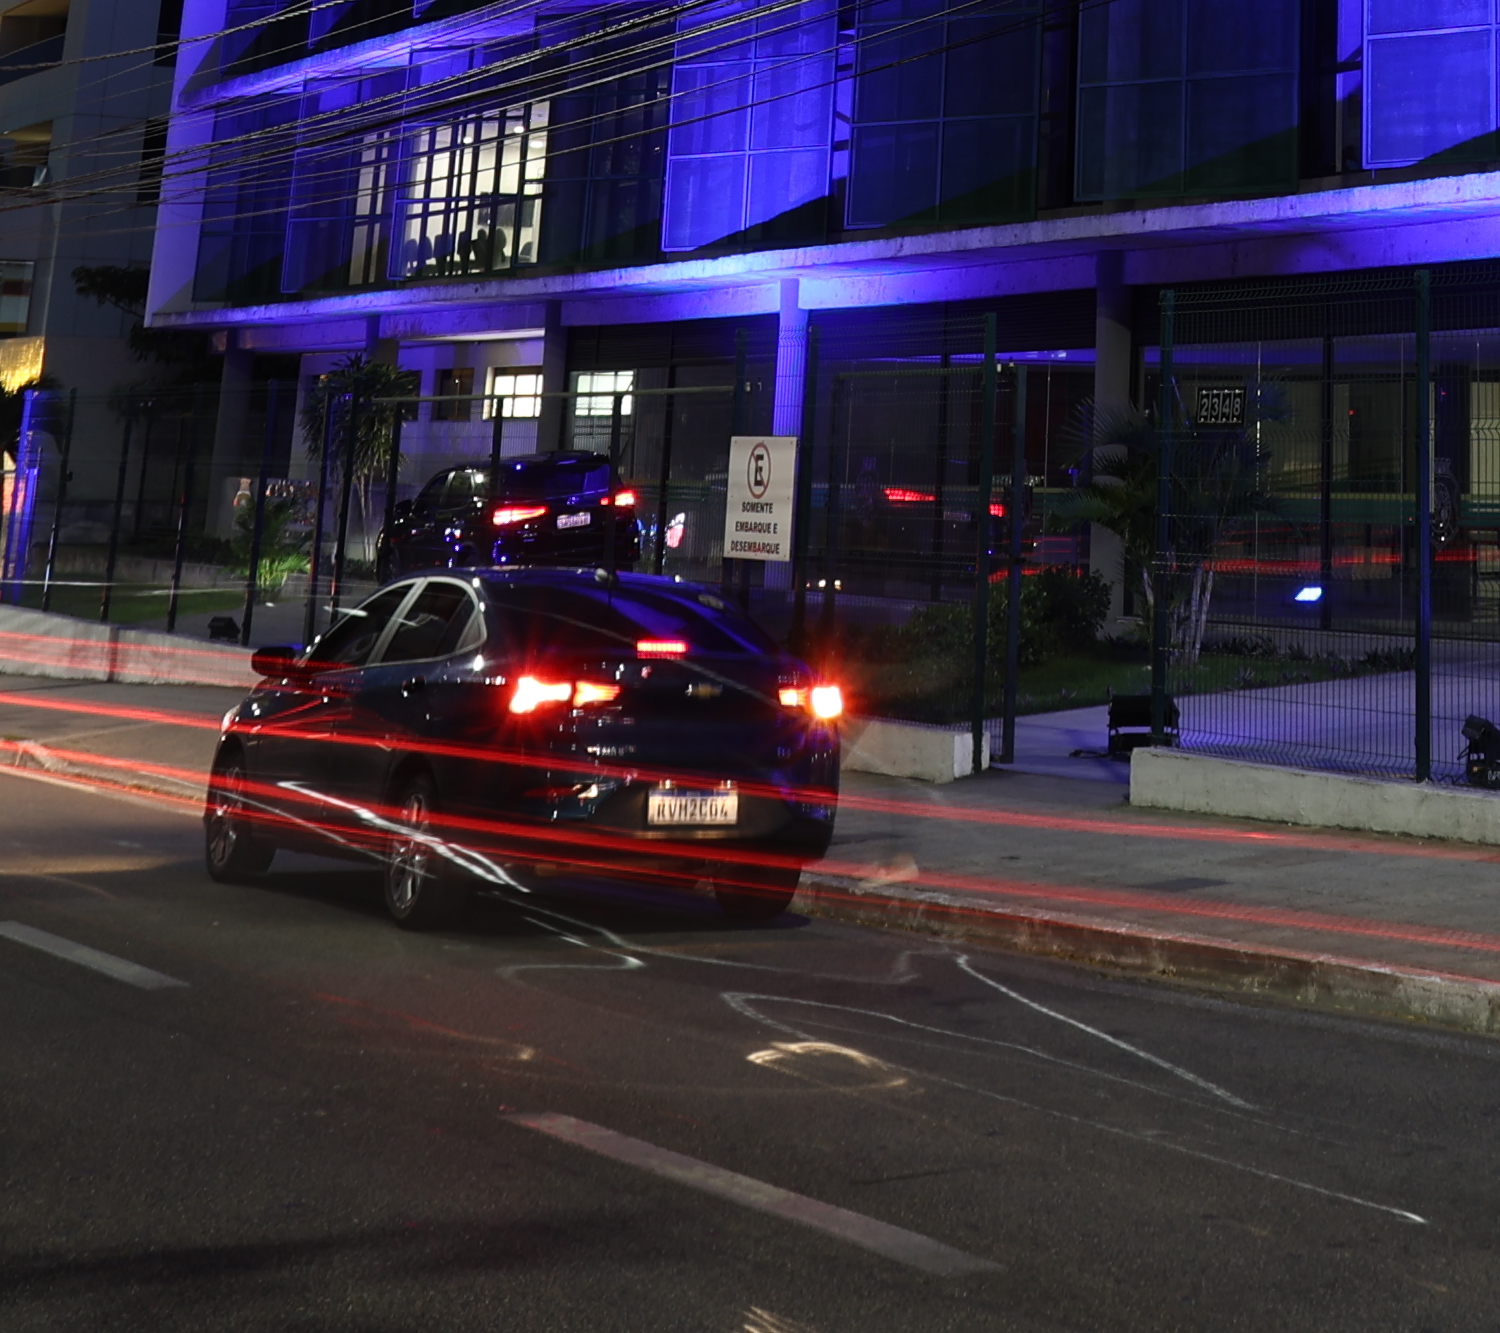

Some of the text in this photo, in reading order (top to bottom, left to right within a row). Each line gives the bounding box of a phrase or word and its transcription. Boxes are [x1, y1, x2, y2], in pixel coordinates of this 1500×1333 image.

[1201, 397, 1240, 416] 2348
[742, 501, 774, 514] SOMENTE
[735, 521, 778, 534] EMBARQUE E
[731, 540, 780, 554] DESEMBARQUE
